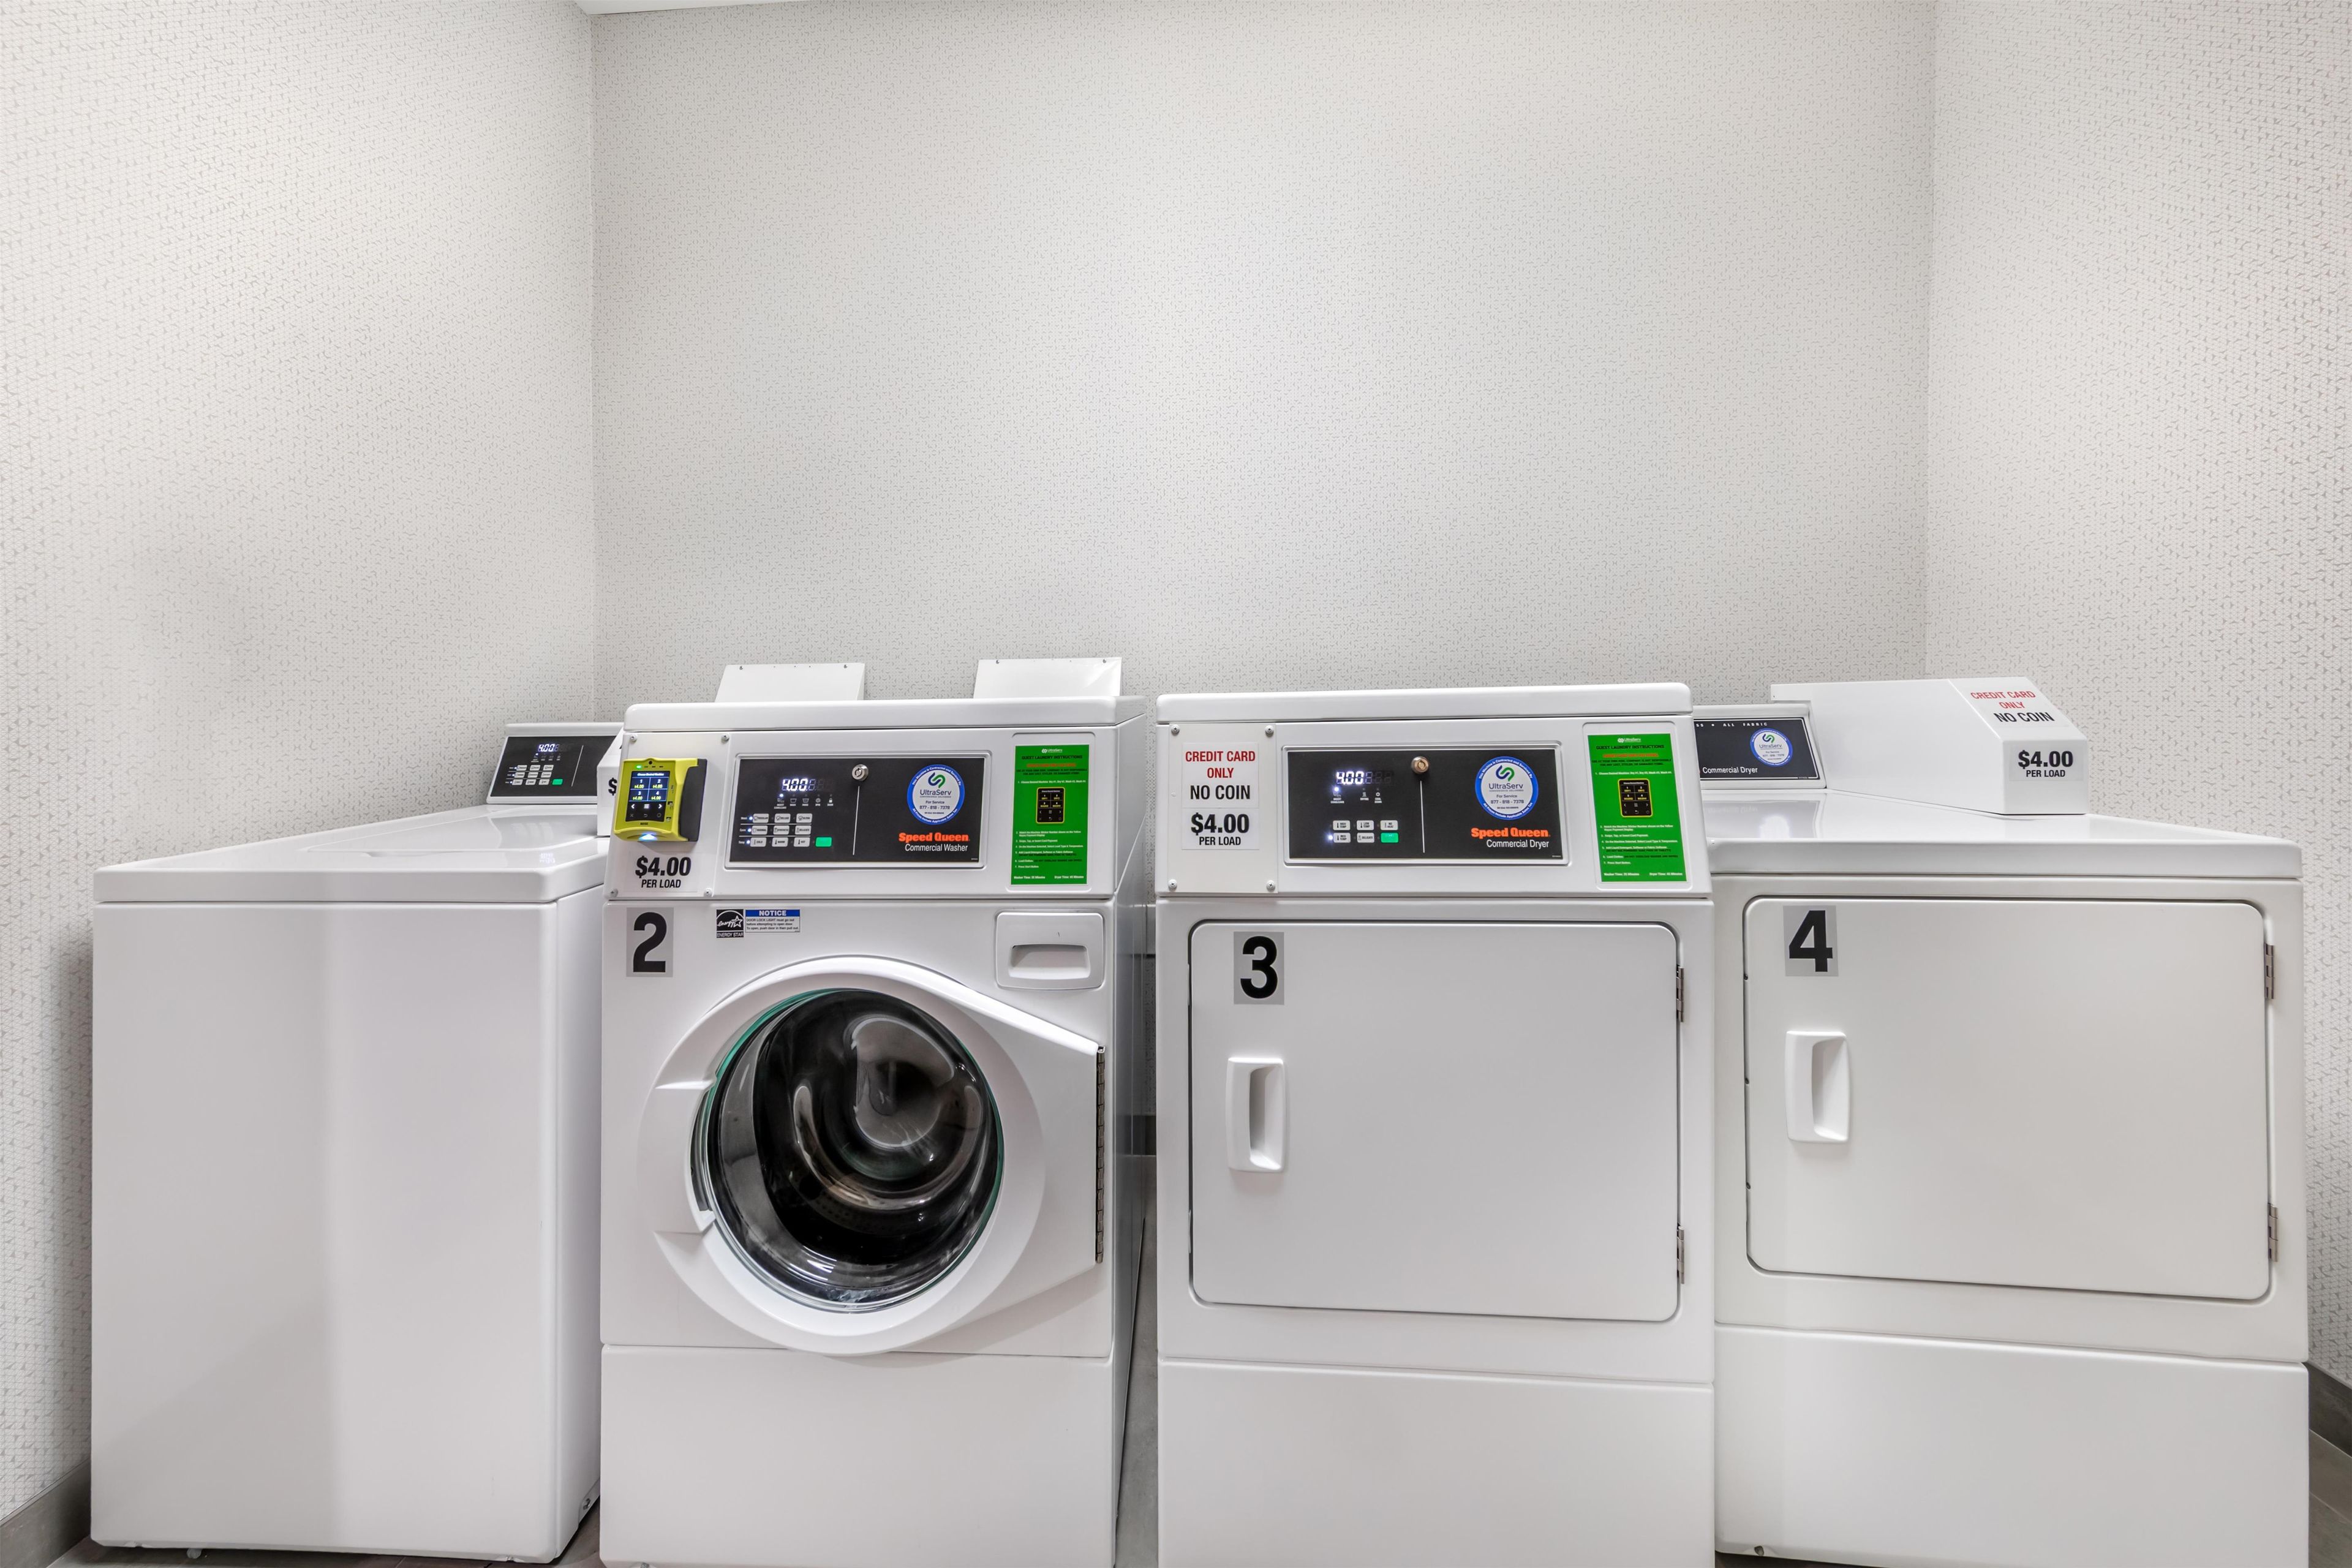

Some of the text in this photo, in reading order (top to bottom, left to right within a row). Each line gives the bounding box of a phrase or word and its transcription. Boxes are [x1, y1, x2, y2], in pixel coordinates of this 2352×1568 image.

[1993, 712, 2055, 722] NO COIN
[1185, 750, 1256, 762] CREDIT CARD
[2018, 750, 2074, 769] $4.00
[1207, 767, 1234, 778] ONLY
[1740, 766, 1758, 775] Dryer
[1336, 771, 1365, 785] 4.00
[782, 778, 809, 791] 4.00
[1190, 785, 1251, 800] NO COIN
[1191, 812, 1250, 835] $4.00
[899, 832, 969, 843] Speed Queen
[1471, 827, 1549, 839] Speed Queen
[1199, 836, 1241, 845] PER LOAD
[1486, 839, 1550, 850] Commercial Dryer
[635, 855, 692, 878] $4.00
[641, 879, 682, 888] PER LOAD
[633, 911, 667, 973] 2
[1789, 910, 1833, 973] 4
[1240, 935, 1278, 999] 3
